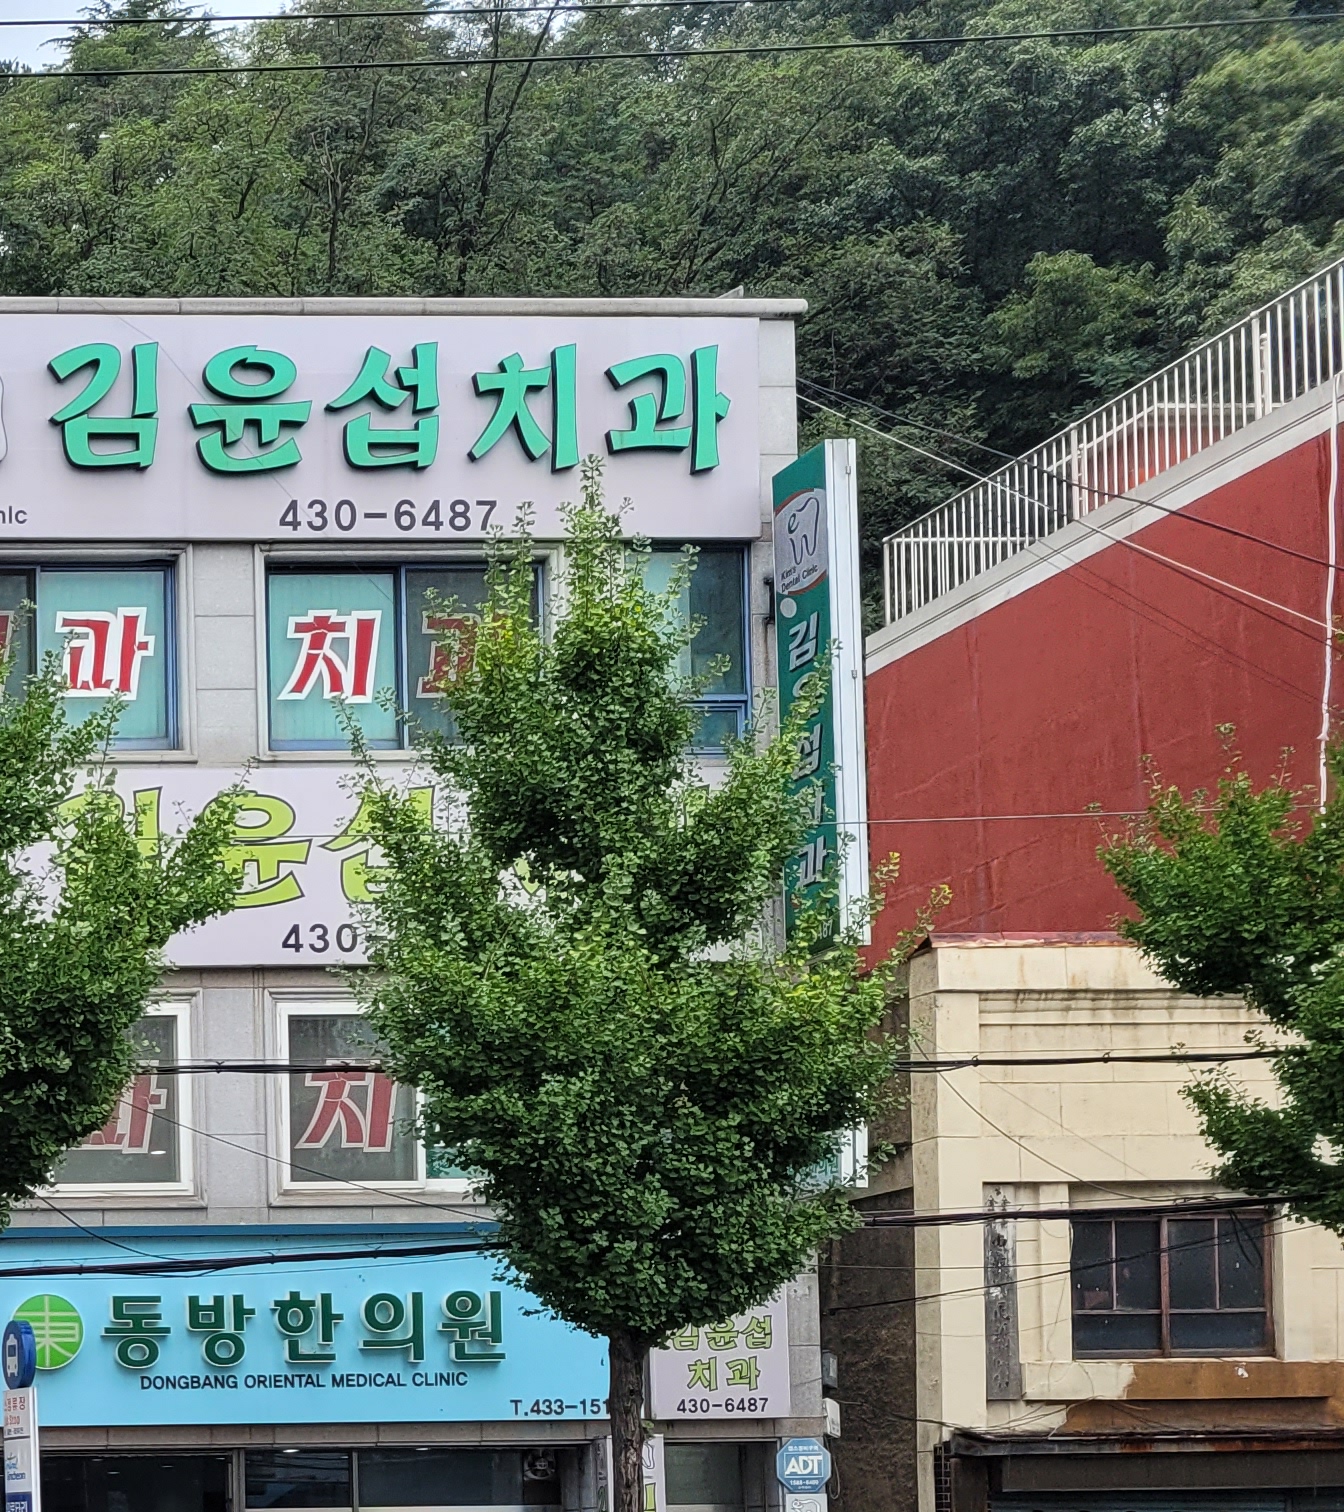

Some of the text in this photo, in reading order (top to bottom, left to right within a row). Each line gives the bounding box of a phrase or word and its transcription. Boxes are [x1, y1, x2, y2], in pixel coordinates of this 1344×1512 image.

[48, 340, 732, 477] 김윤섭치과
[278, 498, 499, 533] 430-6487
[103, 1290, 507, 1370] 동방한의원
[140, 1371, 469, 1391] DONGBANG ORIENTAL MEDICAL CLINIC
[686, 1355, 762, 1393] 치과
[509, 1398, 611, 1417] T.433-151
[676, 1397, 770, 1414] 430-6487
[785, 1455, 823, 1477] ADT
